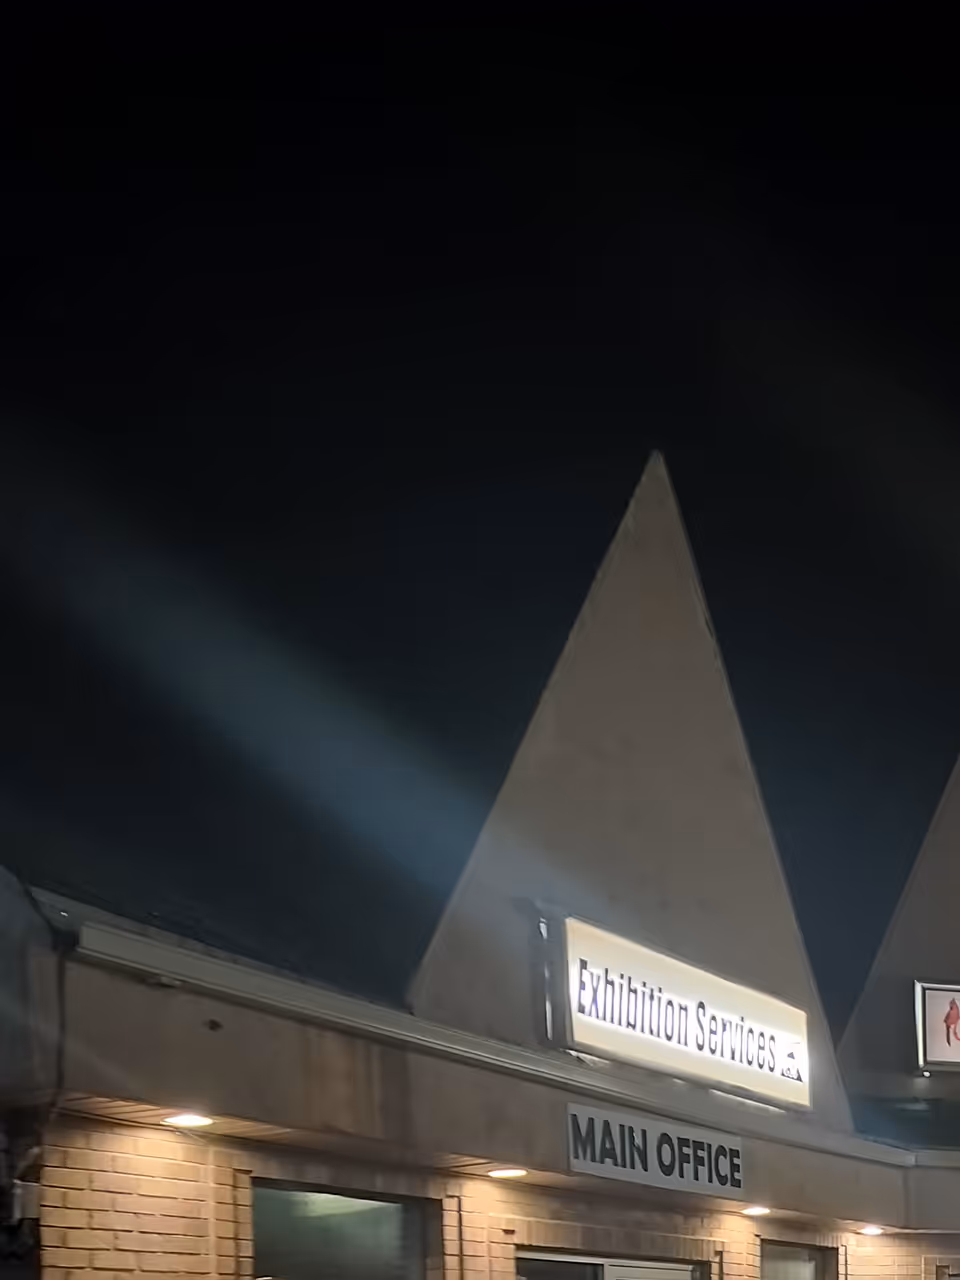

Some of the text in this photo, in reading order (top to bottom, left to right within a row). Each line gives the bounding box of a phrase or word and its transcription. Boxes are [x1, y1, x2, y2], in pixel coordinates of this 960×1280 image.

[577, 957, 777, 1073] Exhibition Services
[570, 1113, 742, 1189] MAIN OFFICE
